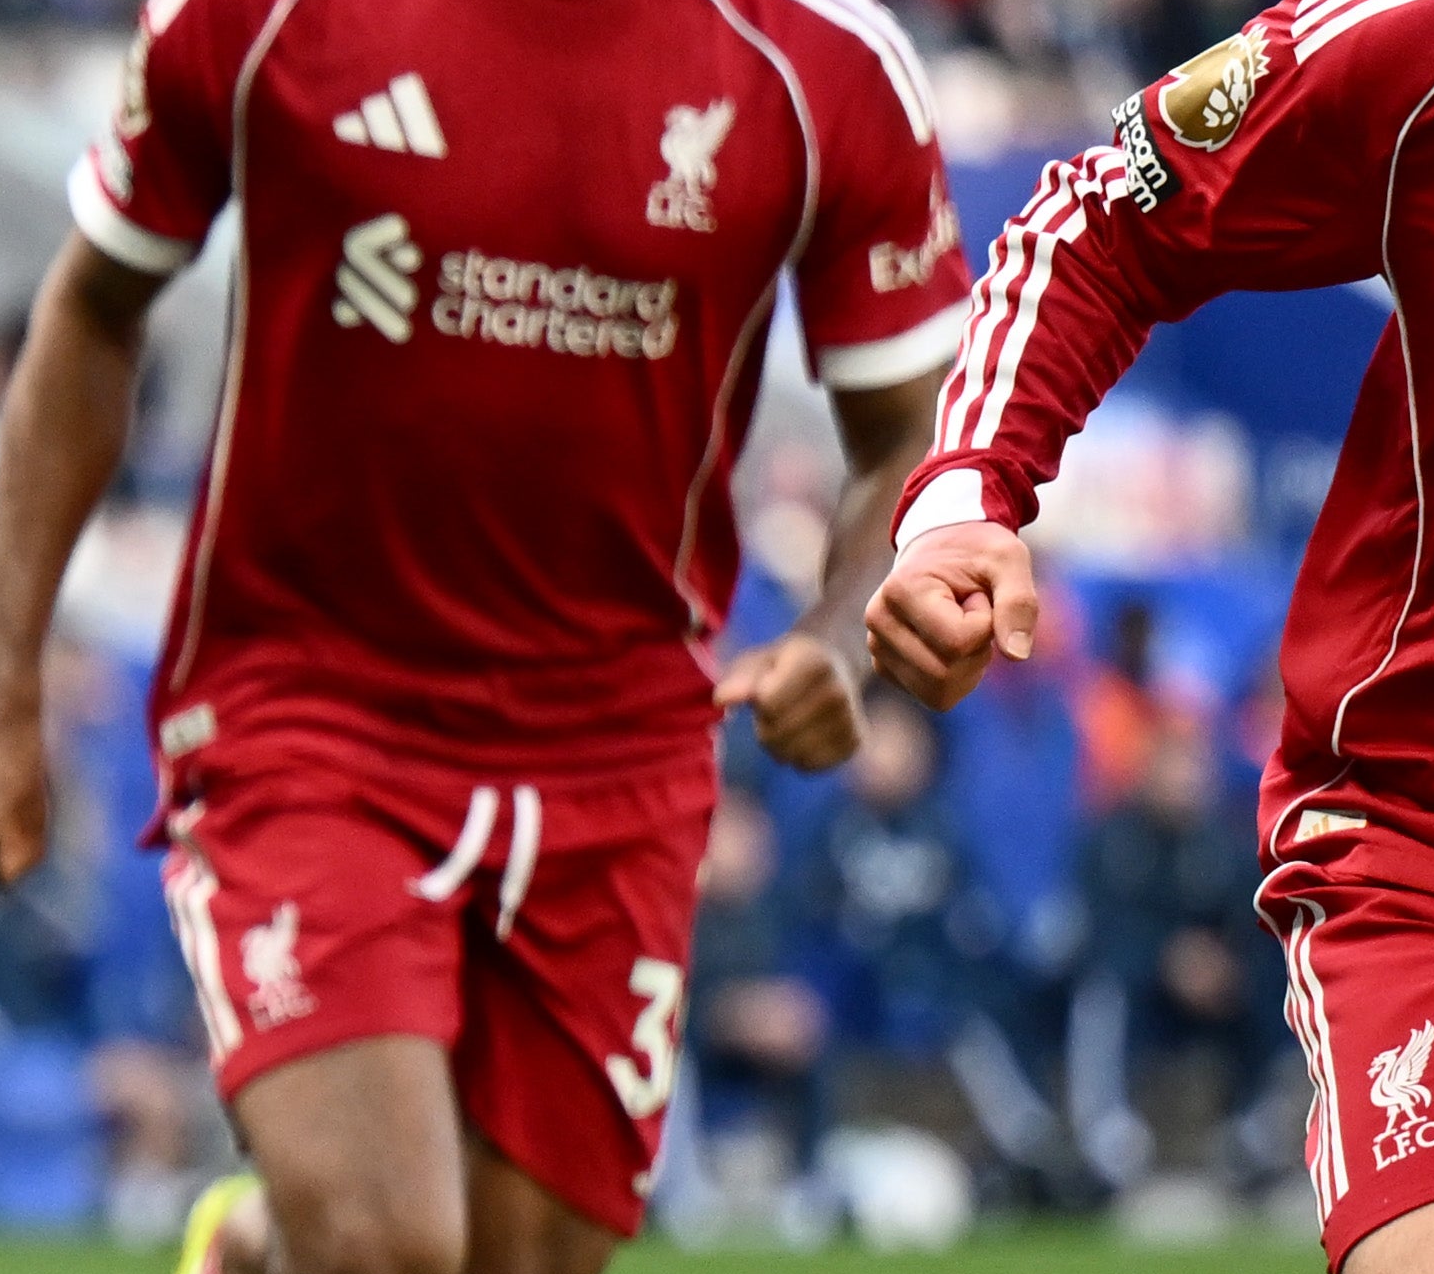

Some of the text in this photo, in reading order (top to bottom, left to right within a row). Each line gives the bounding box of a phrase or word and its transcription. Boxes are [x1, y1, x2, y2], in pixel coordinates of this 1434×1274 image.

[436, 246, 679, 324] standard
[432, 292, 681, 361] chartered
[605, 956, 688, 1119] 3
